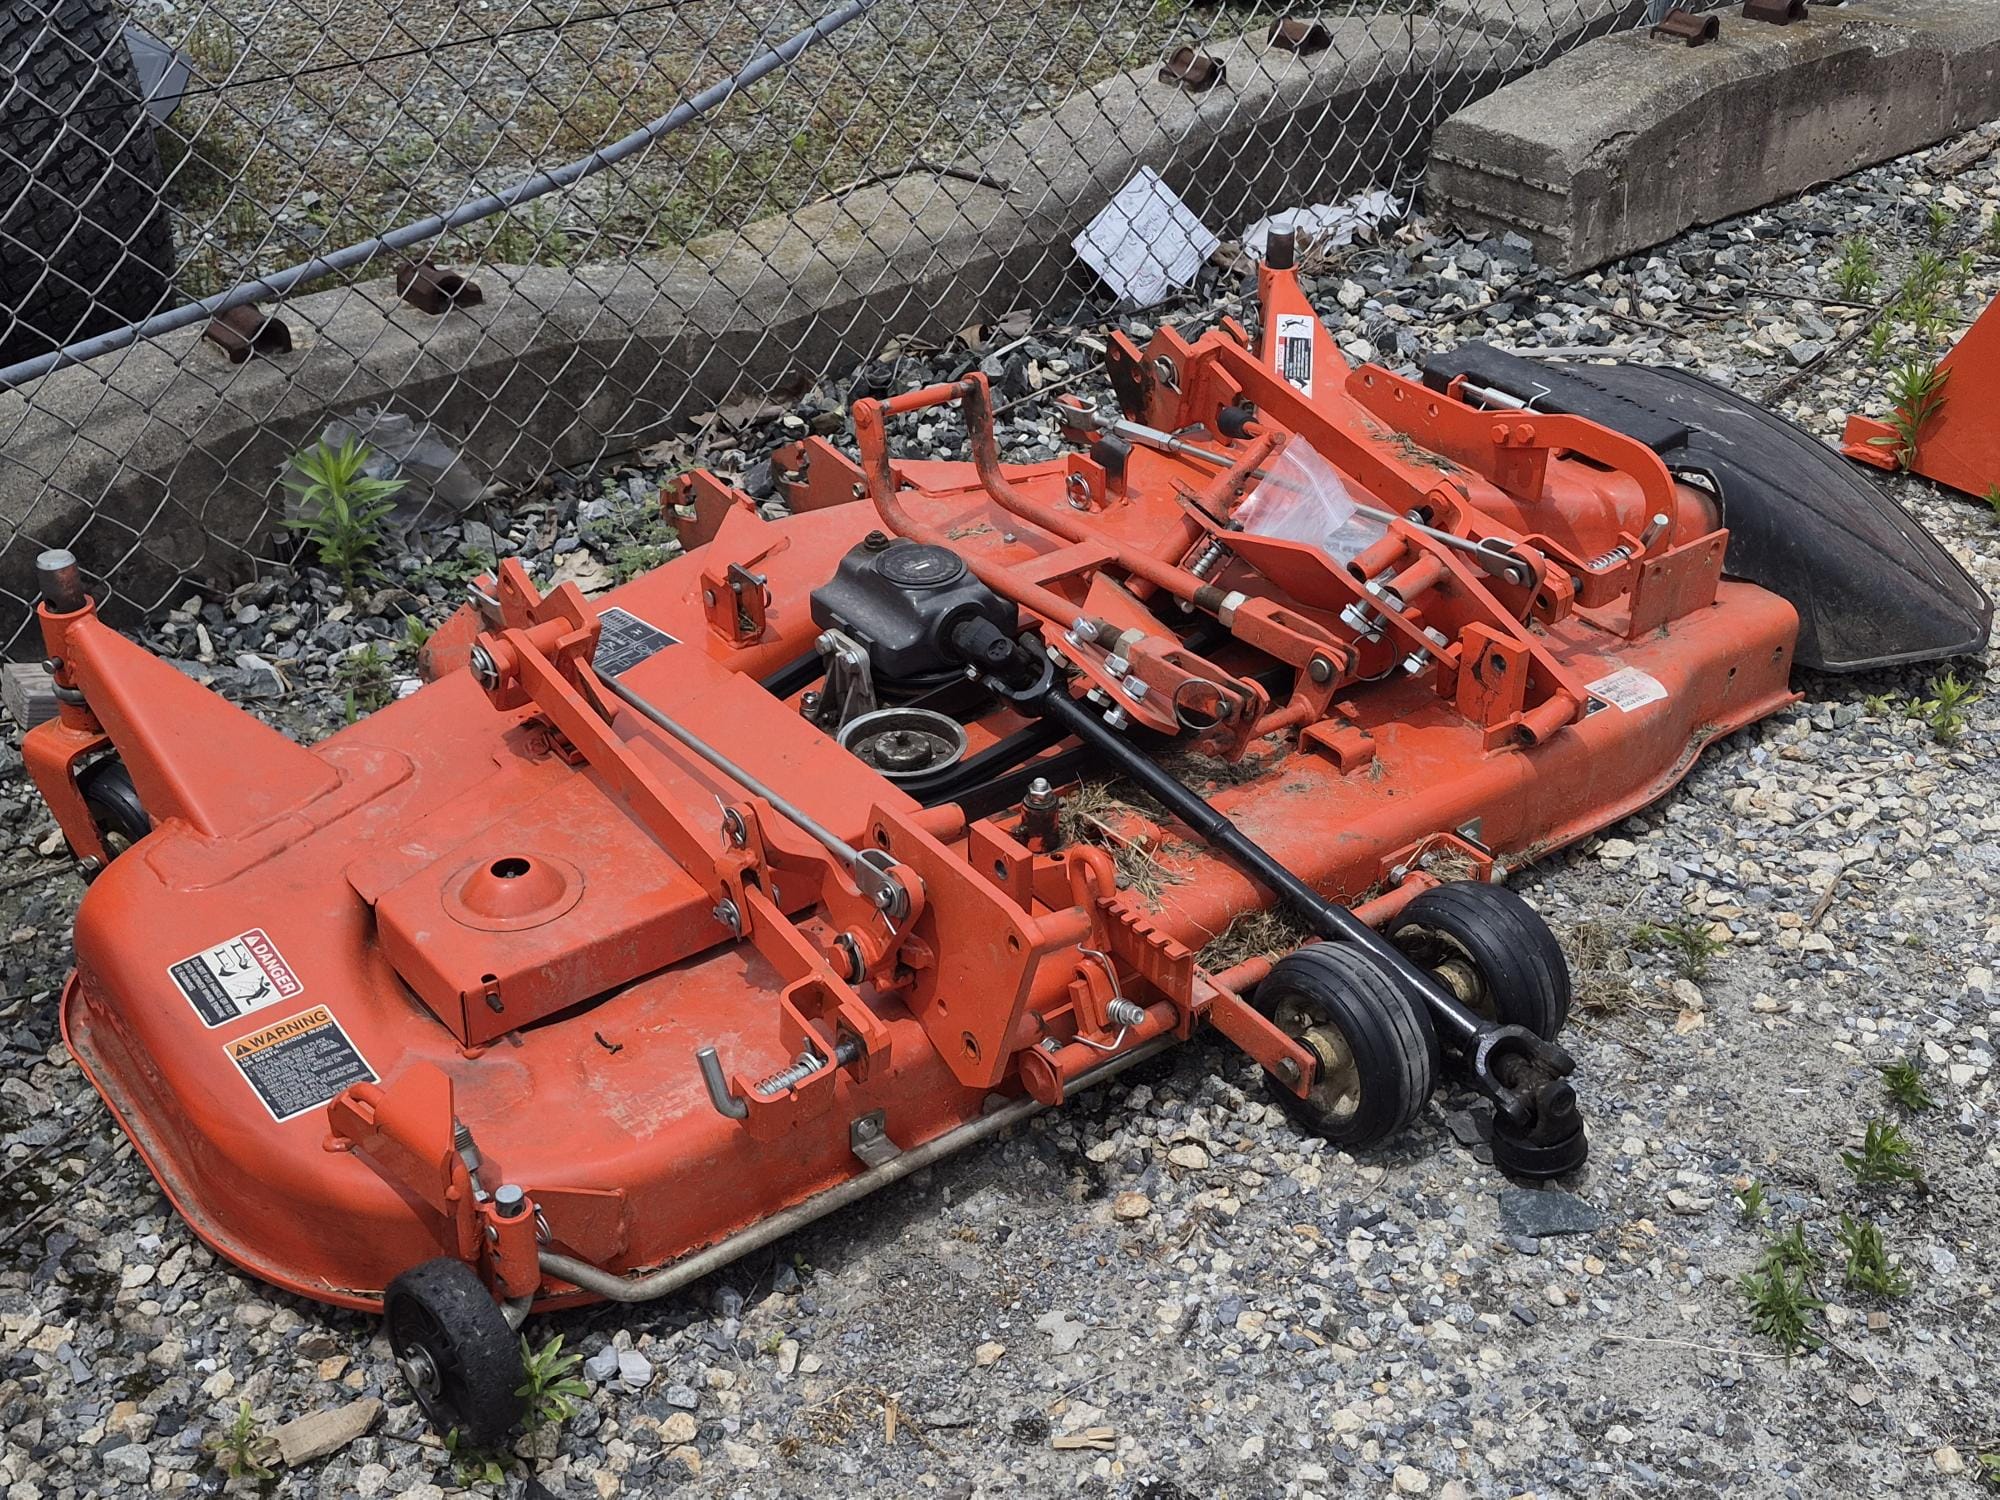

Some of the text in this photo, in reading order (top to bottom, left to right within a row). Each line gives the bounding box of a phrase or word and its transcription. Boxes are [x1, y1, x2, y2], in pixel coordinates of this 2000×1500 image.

[251, 942, 297, 994] DANGER
[249, 1010, 328, 1049] WARNING
[250, 1046, 274, 1058] AVOID
[273, 1032, 307, 1049] SERIOUS
[306, 1021, 334, 1036] INJURY
[241, 1060, 254, 1068] OR
